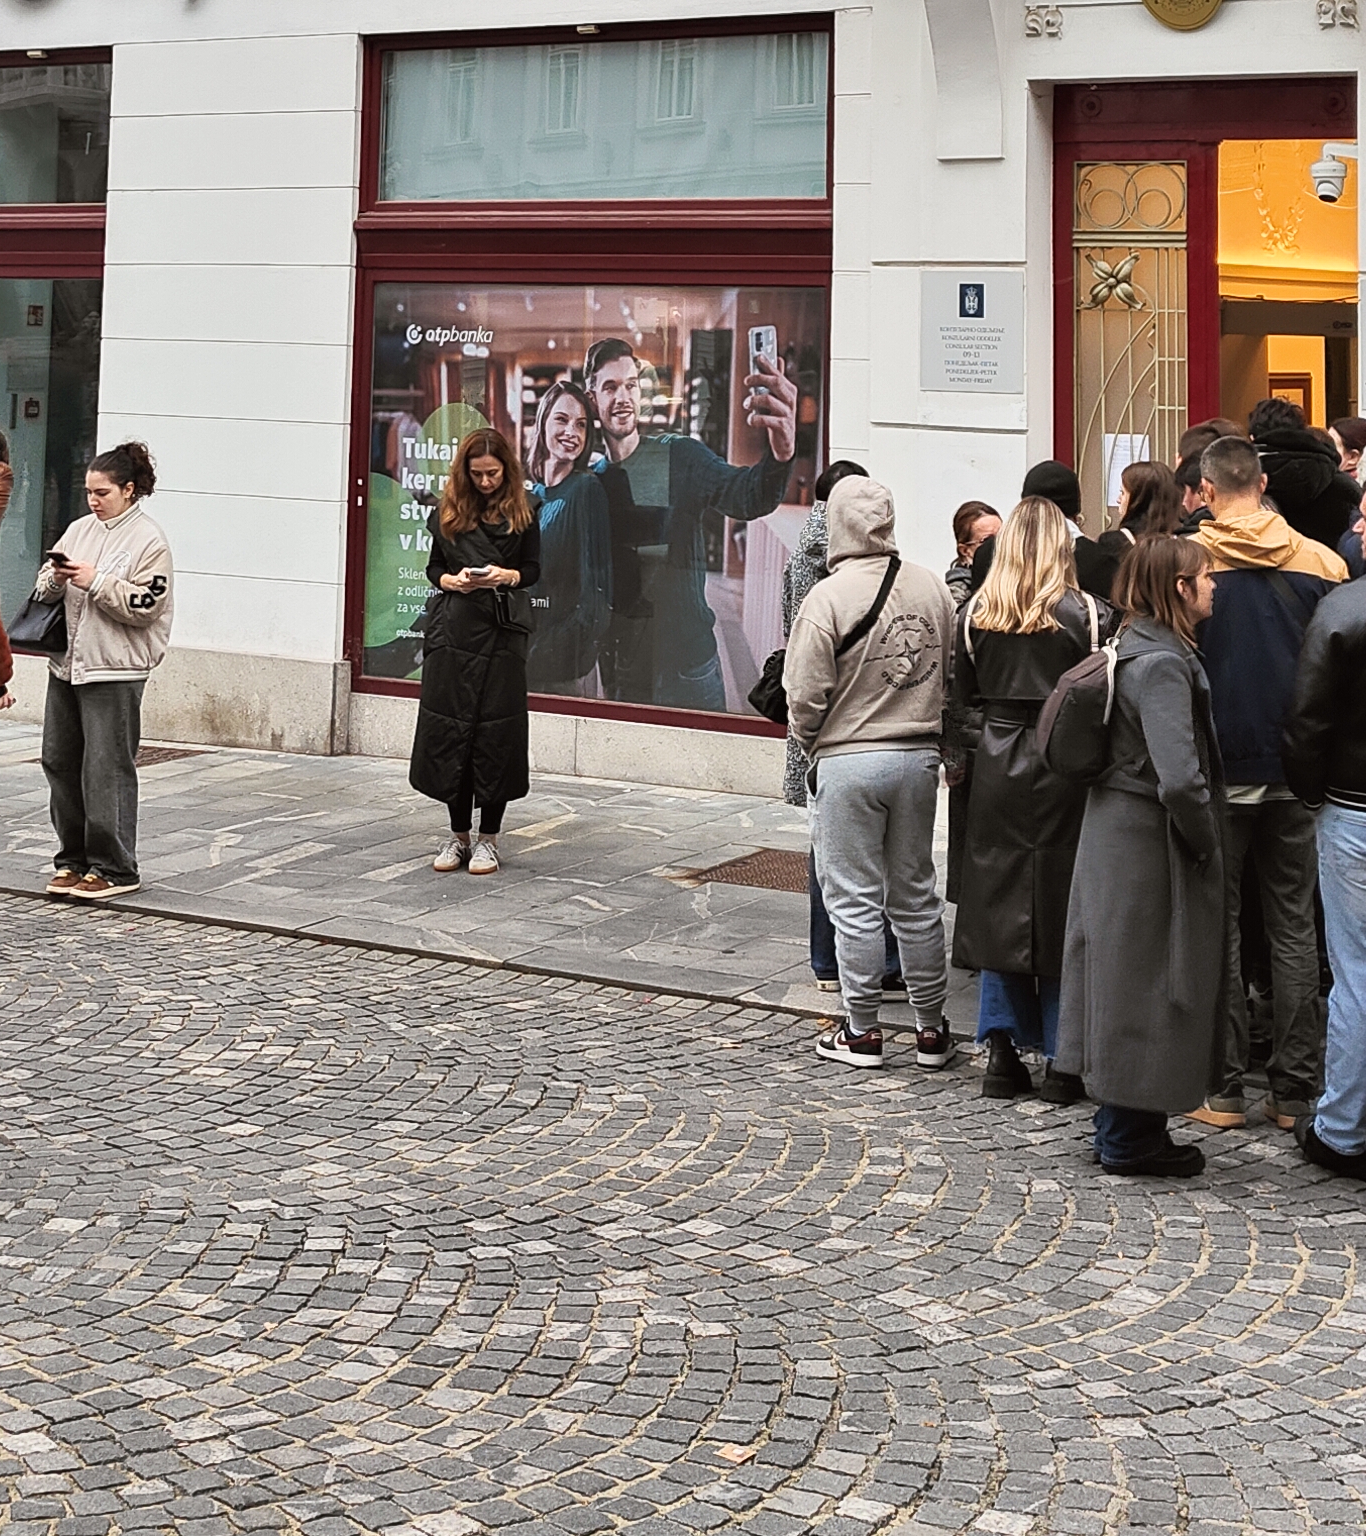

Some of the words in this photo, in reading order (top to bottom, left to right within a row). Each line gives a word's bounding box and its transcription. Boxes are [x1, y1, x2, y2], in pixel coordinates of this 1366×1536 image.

[425, 324, 493, 347] otpbanka
[402, 437, 459, 466] Tukaj
[401, 467, 435, 490] ker
[400, 500, 437, 520] stv
[399, 534, 413, 551] v
[397, 587, 404, 596] z
[397, 603, 409, 613] za
[410, 604, 427, 615] vse
[918, 616, 935, 635] COLD
